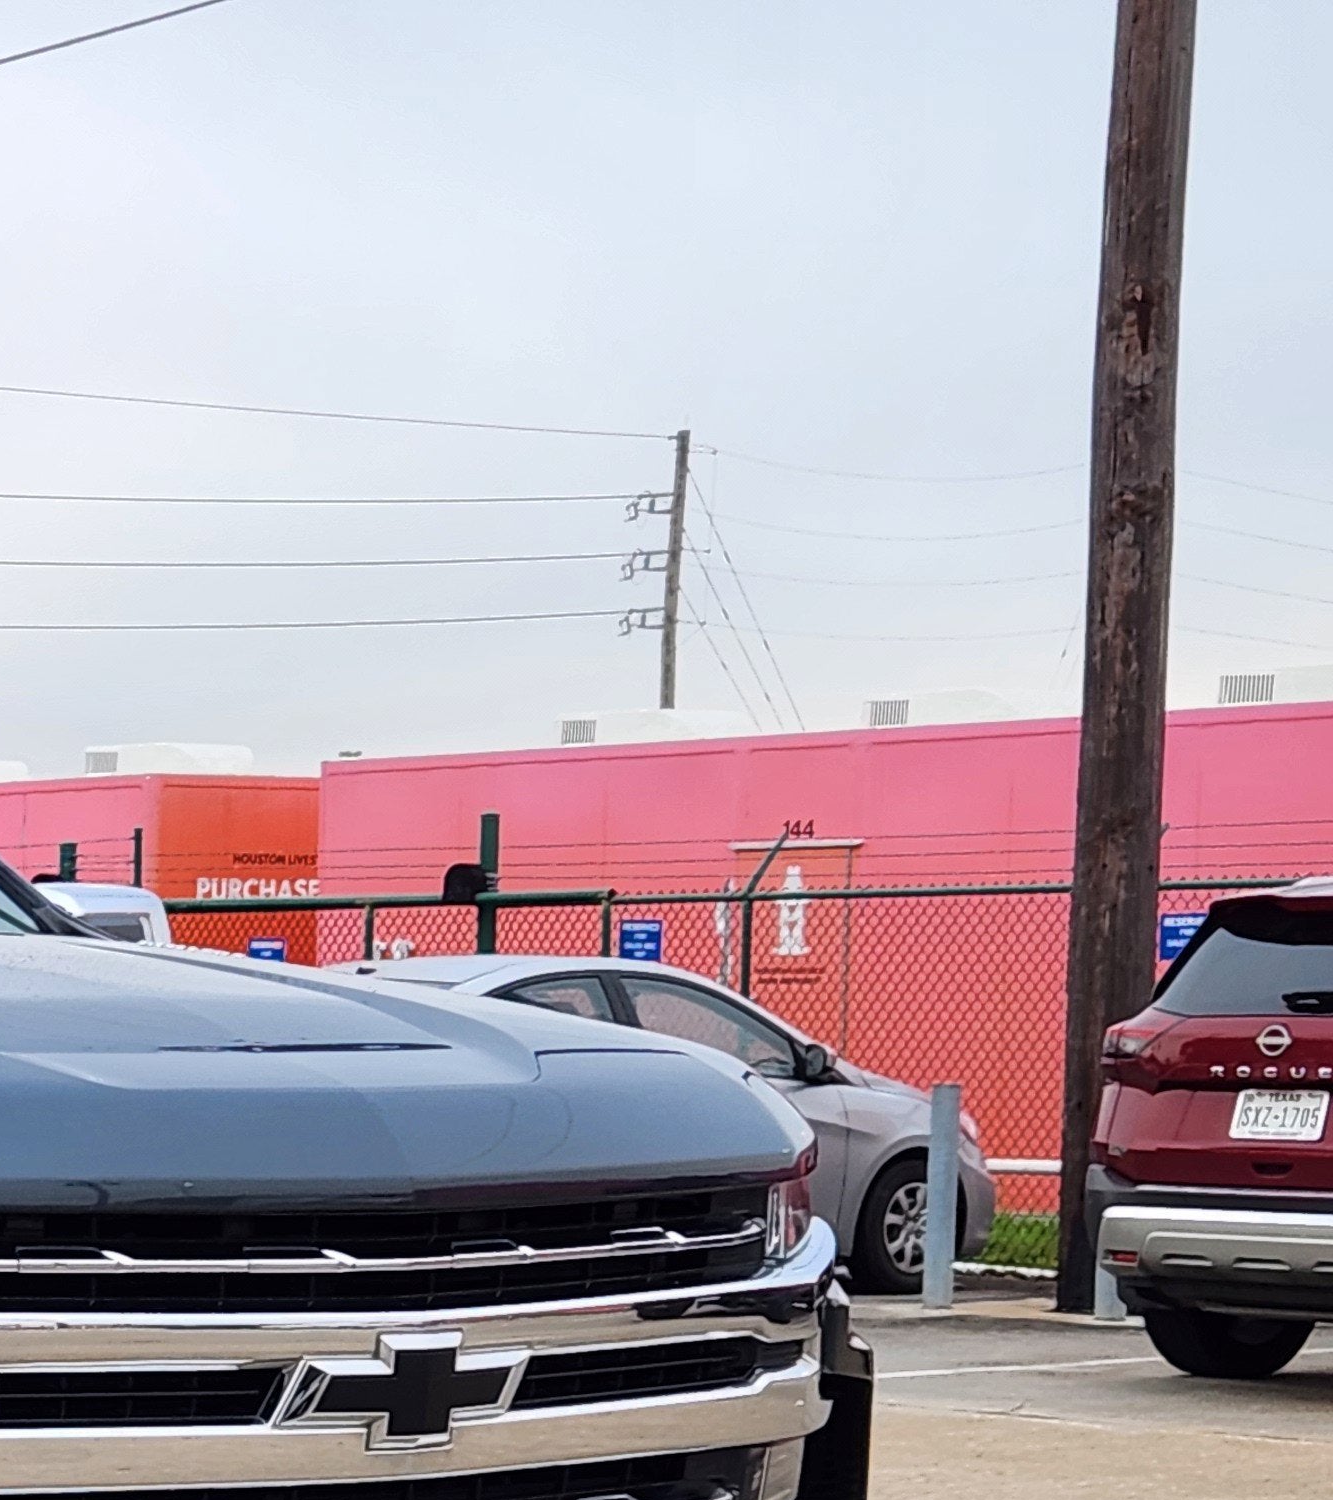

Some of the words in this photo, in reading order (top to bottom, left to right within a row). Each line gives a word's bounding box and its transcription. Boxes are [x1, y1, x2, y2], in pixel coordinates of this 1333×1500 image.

[783, 820, 814, 838] 144
[289, 855, 318, 865] LIVES
[1209, 1065, 1333, 1079] ROGUE
[1269, 1093, 1302, 1102] TEXAS
